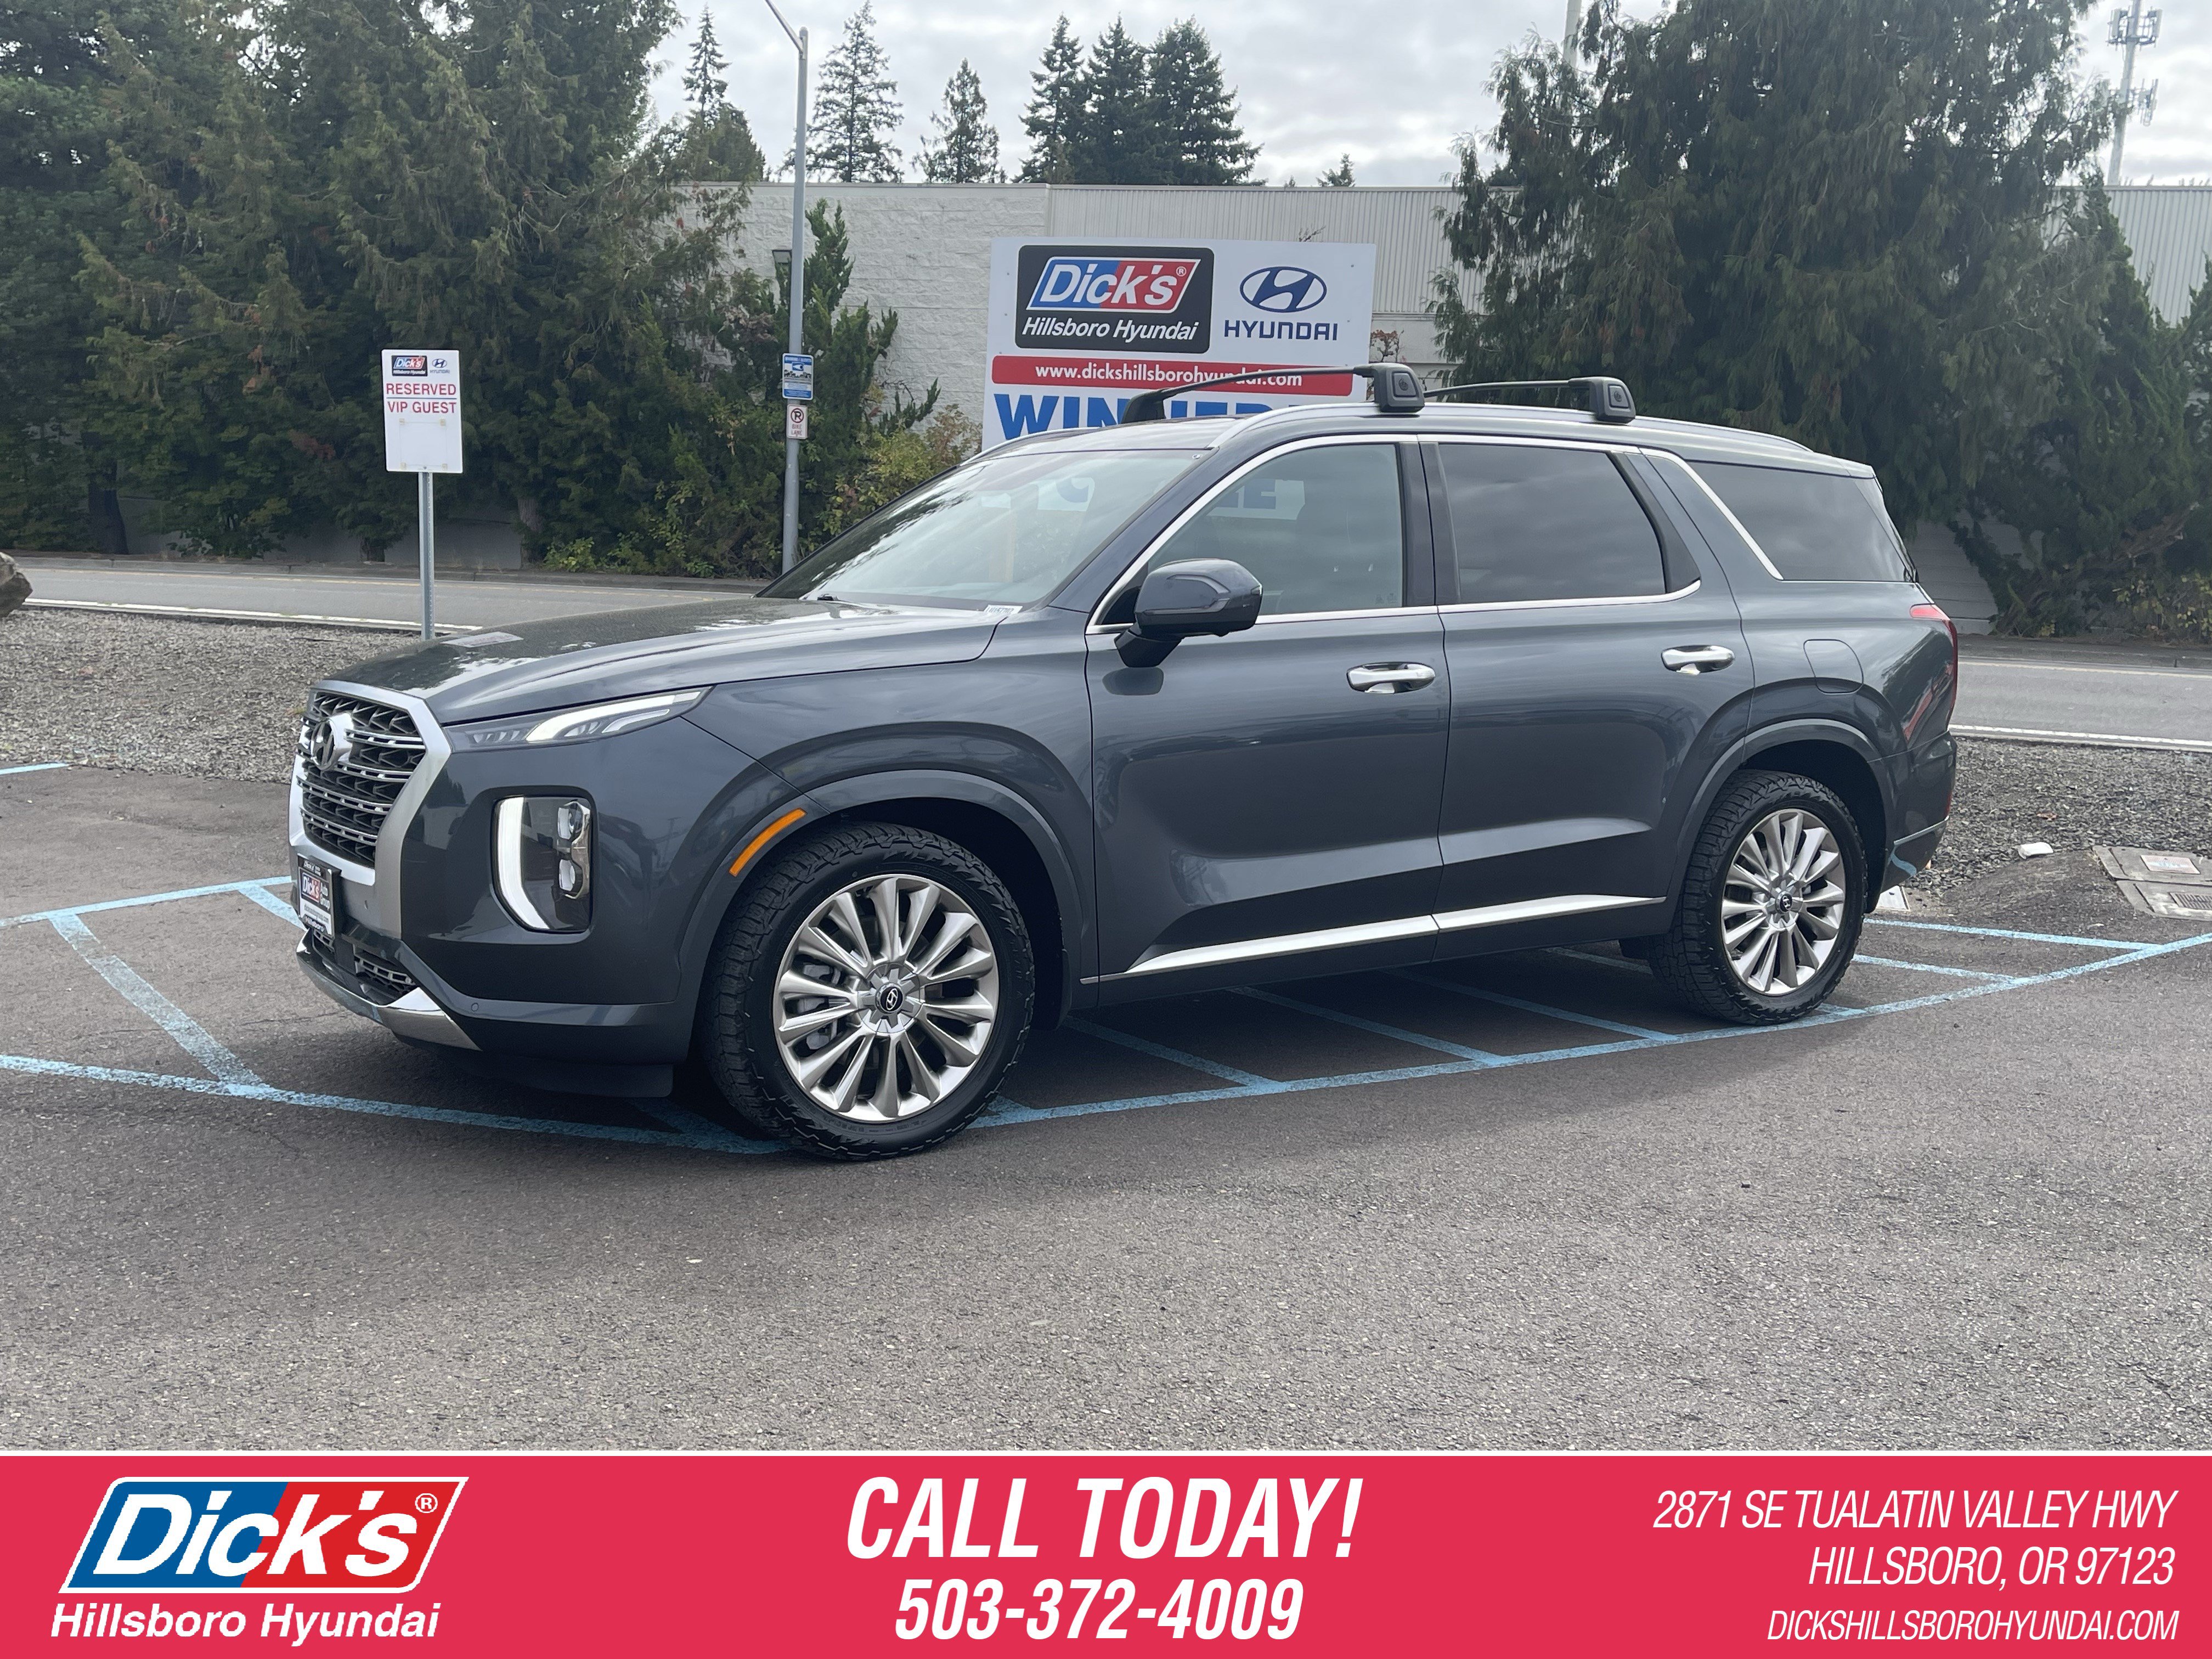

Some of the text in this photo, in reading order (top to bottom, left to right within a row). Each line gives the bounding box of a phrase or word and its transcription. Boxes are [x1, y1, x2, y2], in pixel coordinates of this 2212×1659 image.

[1040, 263, 1178, 306] Dick's
[1022, 317, 1199, 343] Hillsboro Hyundai
[1224, 320, 1338, 341] HYUNDAI
[396, 357, 422, 368] Dick's
[386, 383, 456, 395] RESERVED
[387, 401, 456, 414] VIP GUEST
[302, 876, 319, 899] Dick's
